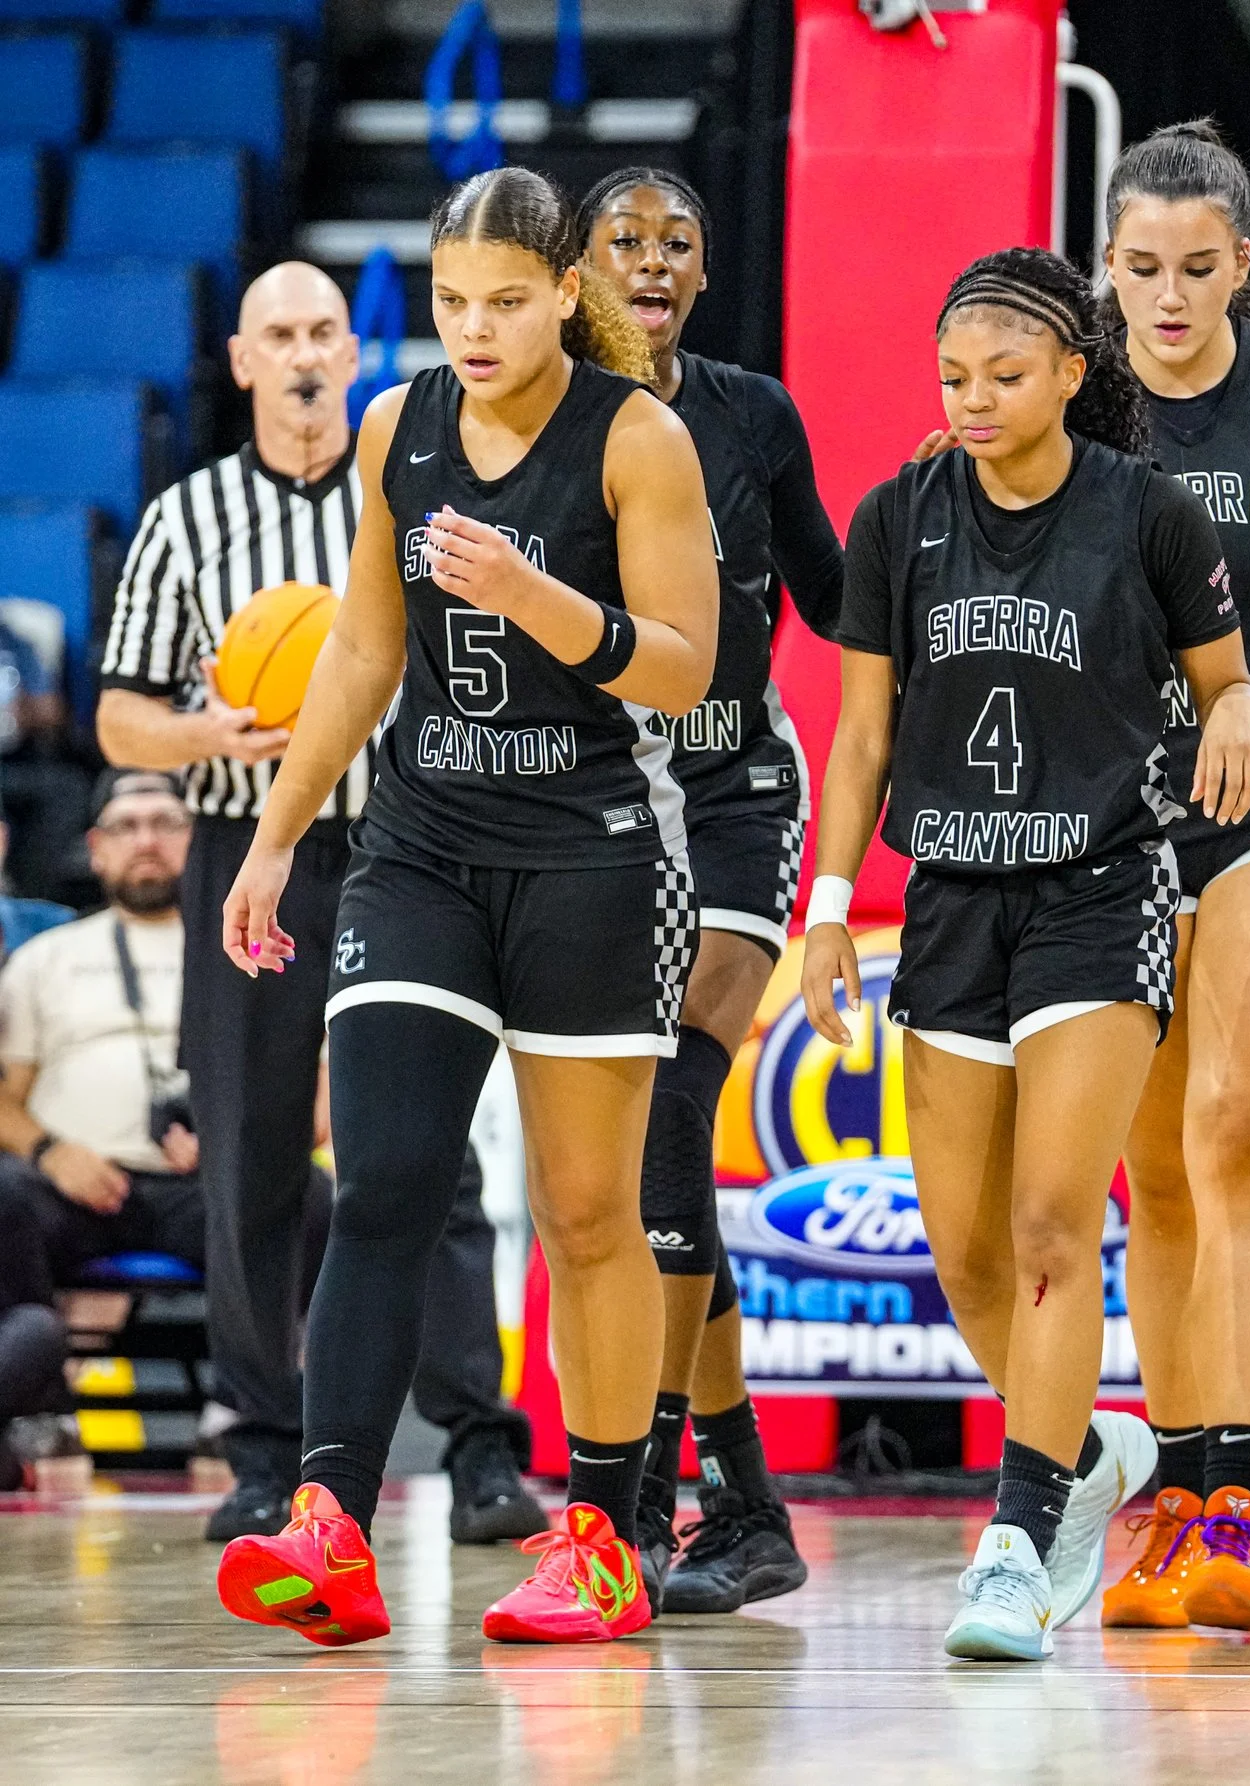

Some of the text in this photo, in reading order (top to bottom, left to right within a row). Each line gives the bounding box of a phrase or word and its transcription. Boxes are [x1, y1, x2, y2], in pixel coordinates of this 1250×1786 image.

[445, 607, 508, 717] 5
[928, 595, 1082, 671] SIERRA
[417, 715, 576, 775] CANYON
[966, 687, 1022, 794] 4
[911, 809, 1088, 864] CANYON
